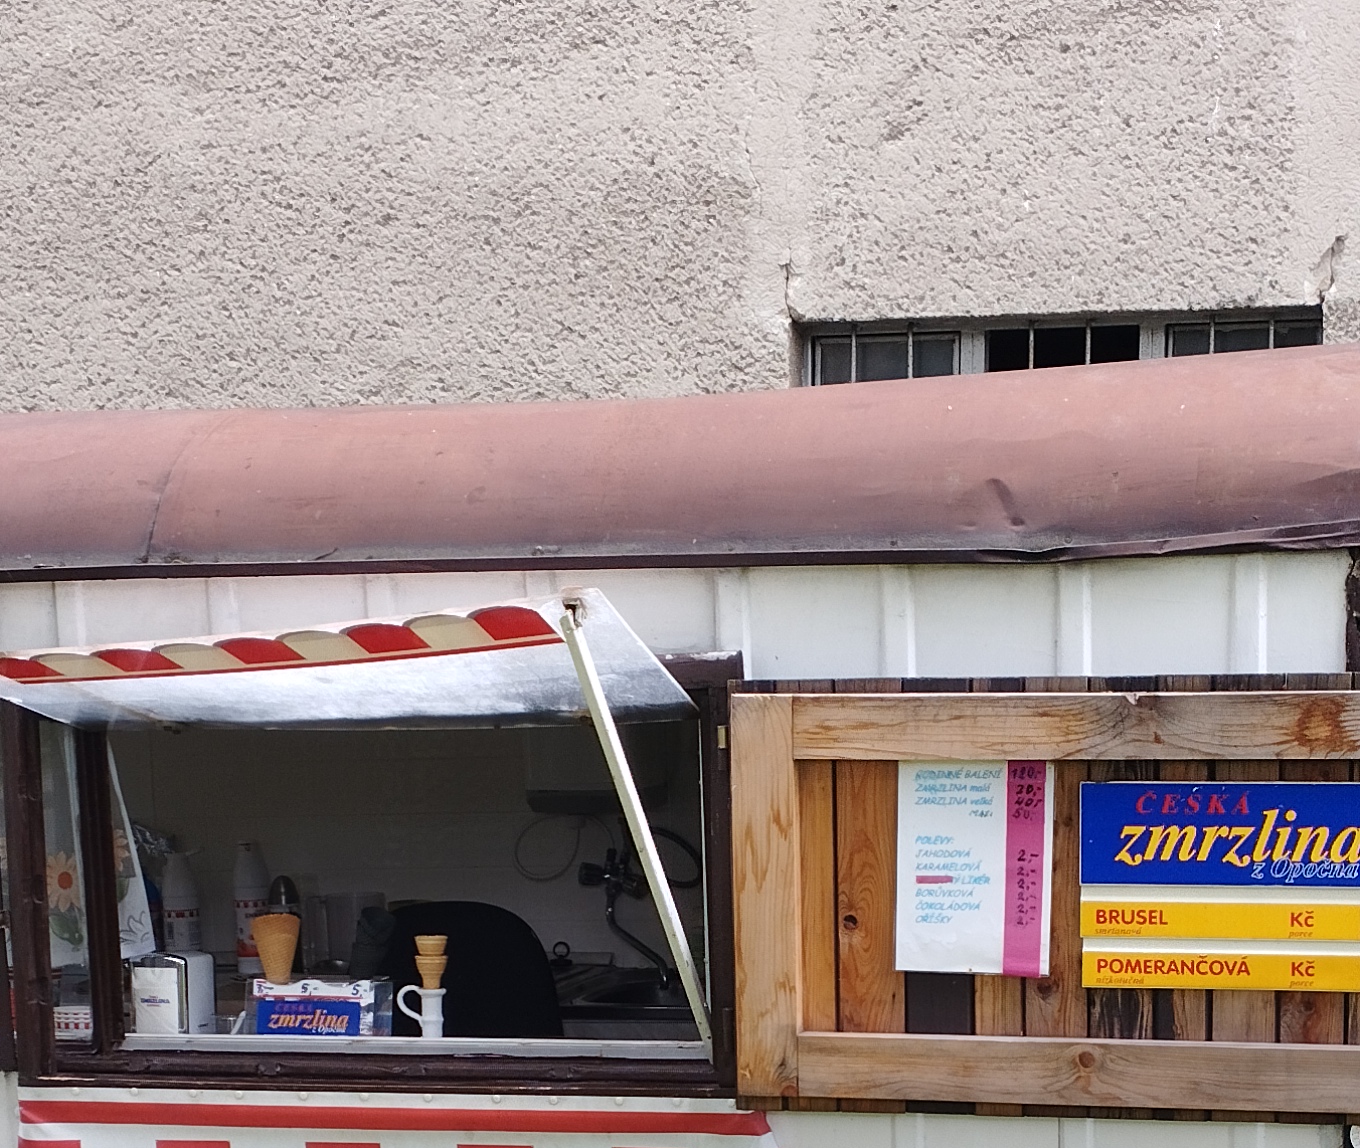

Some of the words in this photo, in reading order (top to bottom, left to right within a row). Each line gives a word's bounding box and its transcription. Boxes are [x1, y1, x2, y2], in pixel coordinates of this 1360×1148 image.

[964, 768, 1002, 779] BALENÍ
[915, 783, 967, 793] ZMRZLINA
[915, 796, 967, 805] ZMRZLINA
[1135, 790, 1251, 815] ČESKÁ
[915, 835, 954, 844] POLEVY:
[915, 847, 972, 858] JAHODOVÁ
[915, 860, 982, 871] KARAMELOVÁ
[1251, 863, 1264, 879] z
[1271, 858, 1360, 883] Opočna
[915, 886, 975, 897] BORŮVKOVÁ
[915, 900, 982, 911] ČOKOLÁDOVÁ
[915, 913, 952, 923] OŘÍŠKY
[1095, 909, 1168, 926] BRUSEL
[1290, 910, 1314, 928] Kč
[1288, 931, 1313, 939] porce
[1096, 954, 1251, 976] POMERANČOVÁ
[1290, 961, 1315, 977] Kč
[1290, 980, 1314, 988] porce
[268, 1009, 349, 1029] zmrzlina
